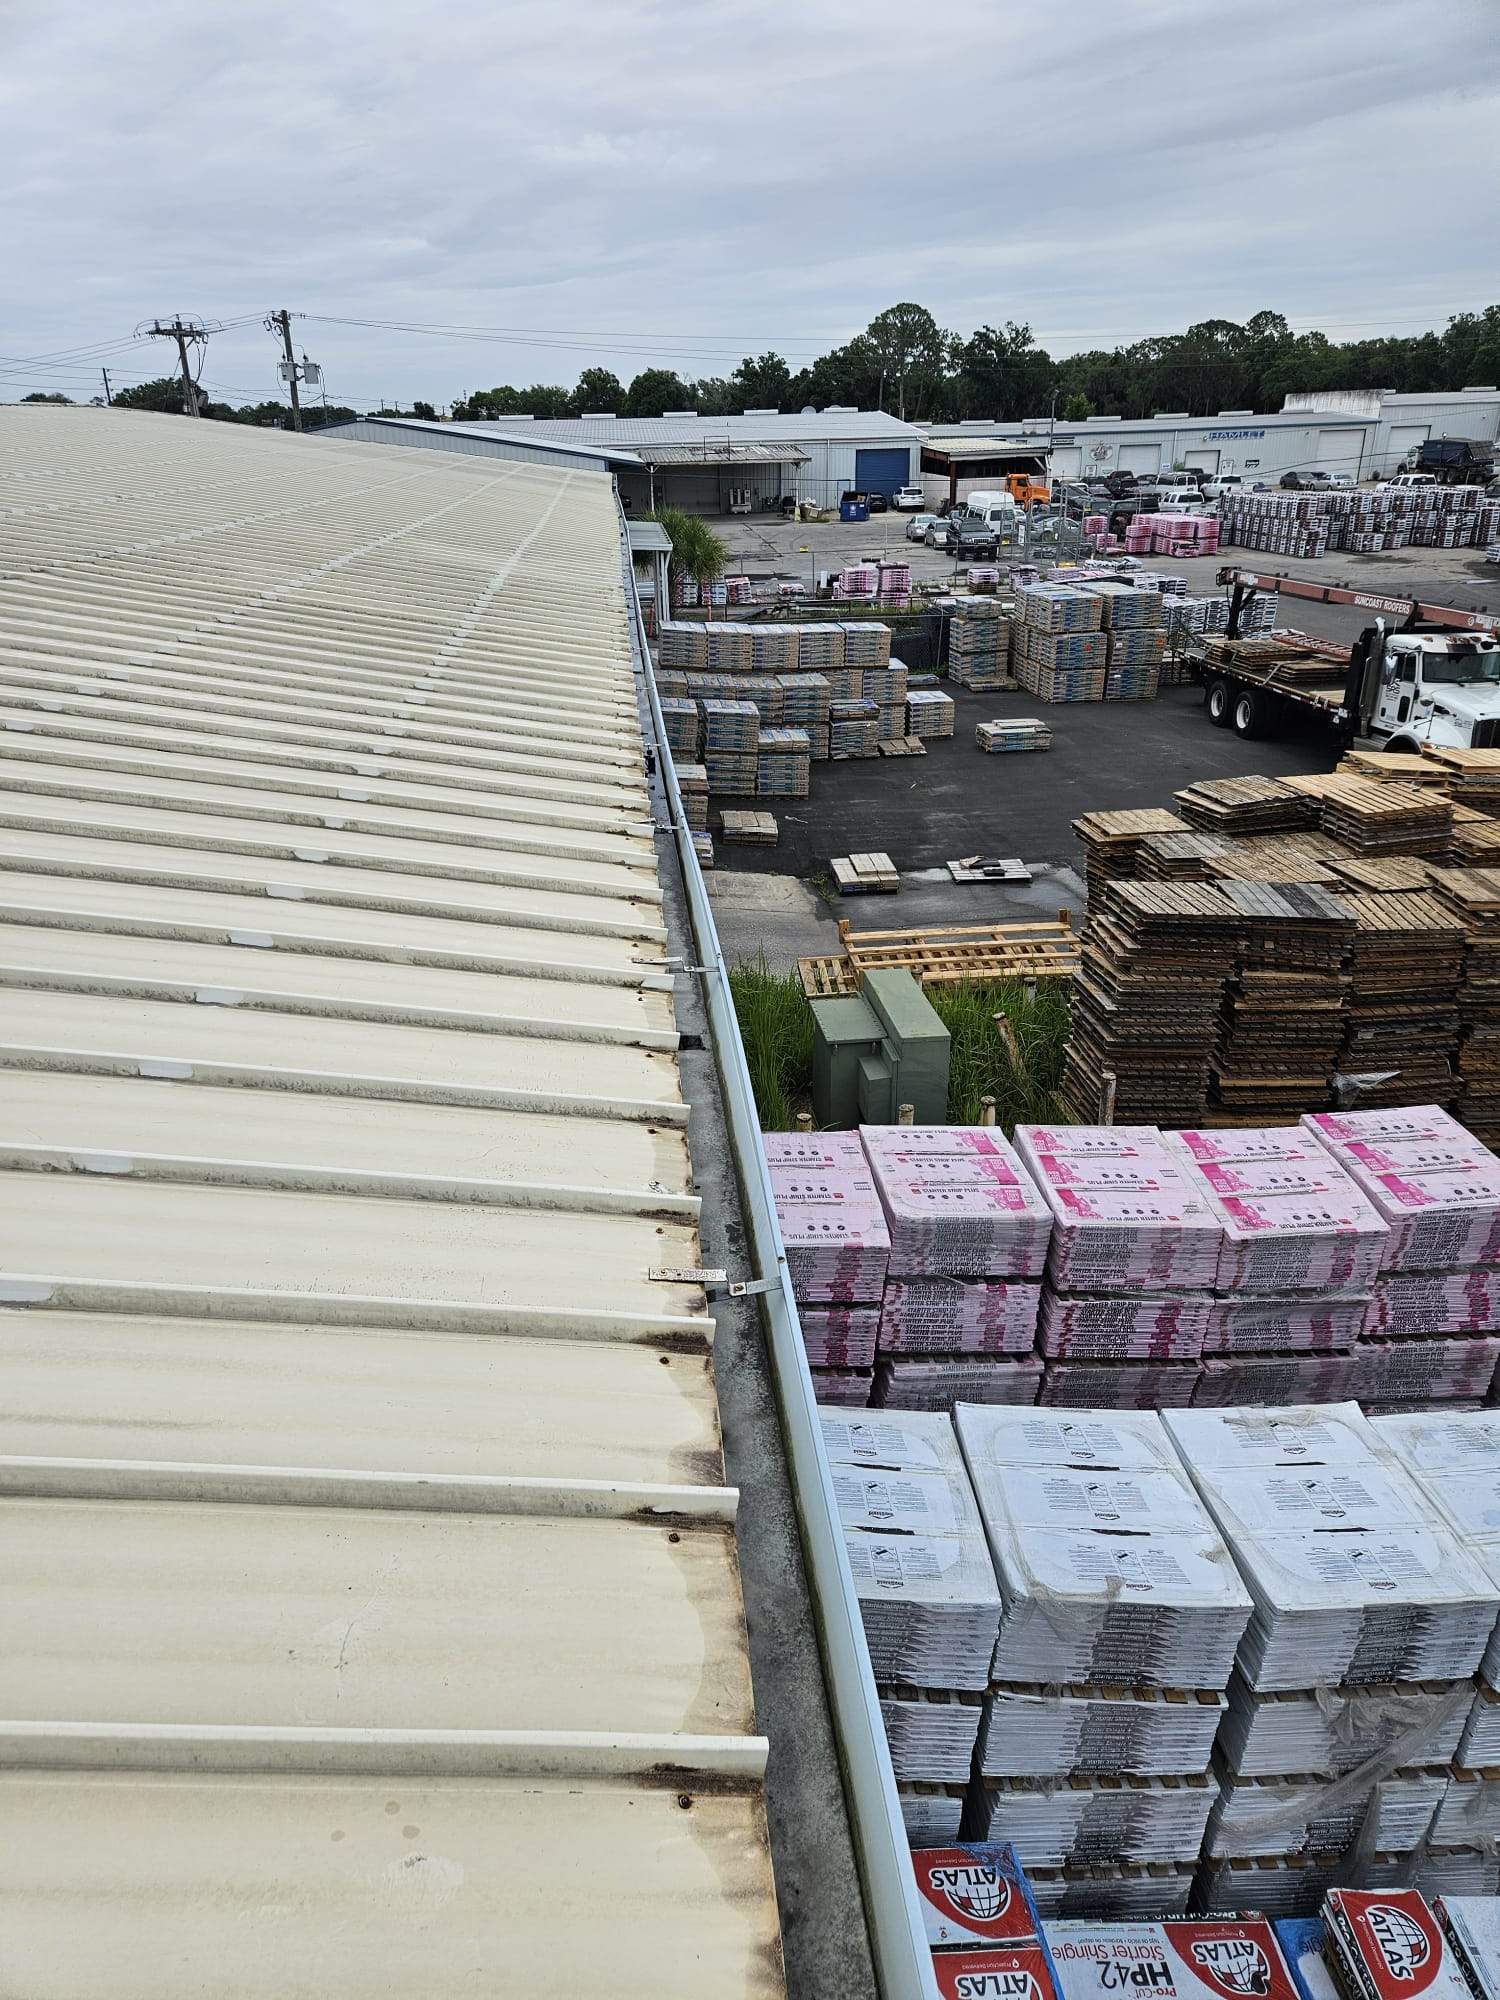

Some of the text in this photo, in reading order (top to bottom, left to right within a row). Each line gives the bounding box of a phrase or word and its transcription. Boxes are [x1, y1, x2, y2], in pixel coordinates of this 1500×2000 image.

[1354, 596, 1410, 614] SUNCOAST ROOFERS
[931, 1868, 996, 1888] ATLAS
[1052, 1943, 1165, 1960] Starter Shingle
[1194, 1942, 1254, 1962] ATLAS
[1368, 1911, 1411, 1979] ATLAS
[1096, 1961, 1174, 1989] HP42
[957, 1974, 1028, 1997] ATLAS
[1135, 1987, 1176, 1998] Pro-Cut
